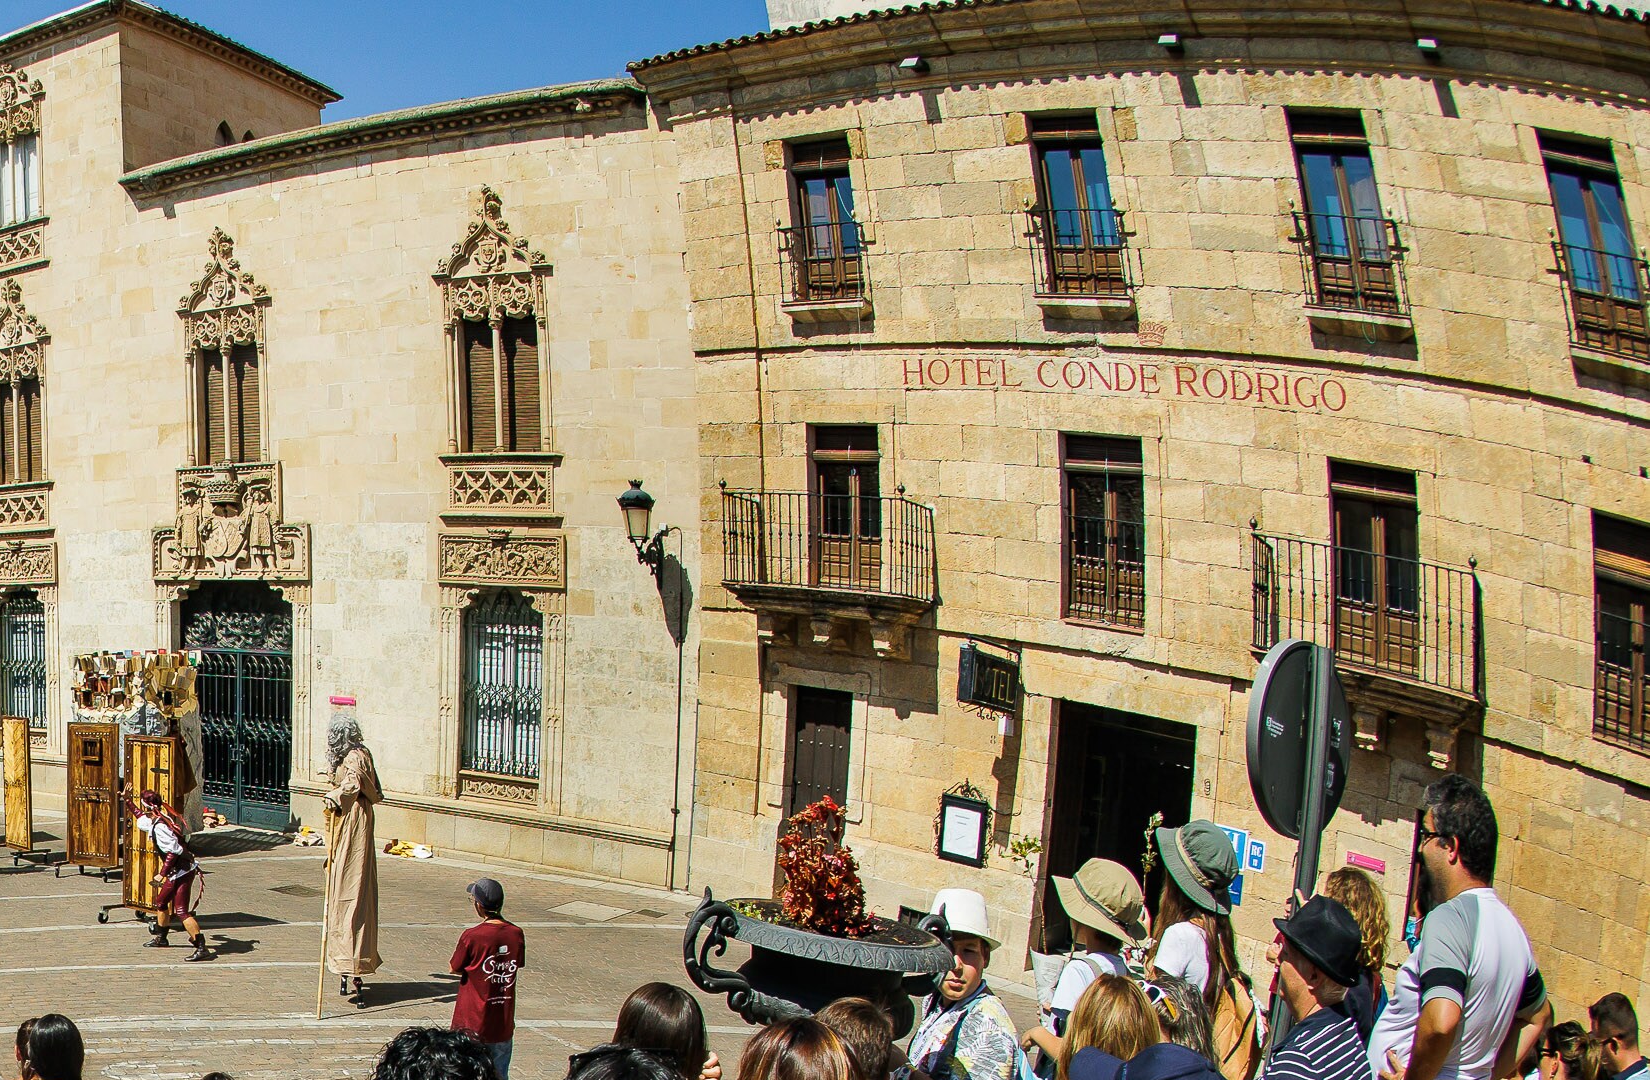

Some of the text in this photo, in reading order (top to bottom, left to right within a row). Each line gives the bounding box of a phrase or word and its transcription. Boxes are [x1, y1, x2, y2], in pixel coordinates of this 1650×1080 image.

[902, 358, 1348, 412] HOTEL CONDE RODRIGO
